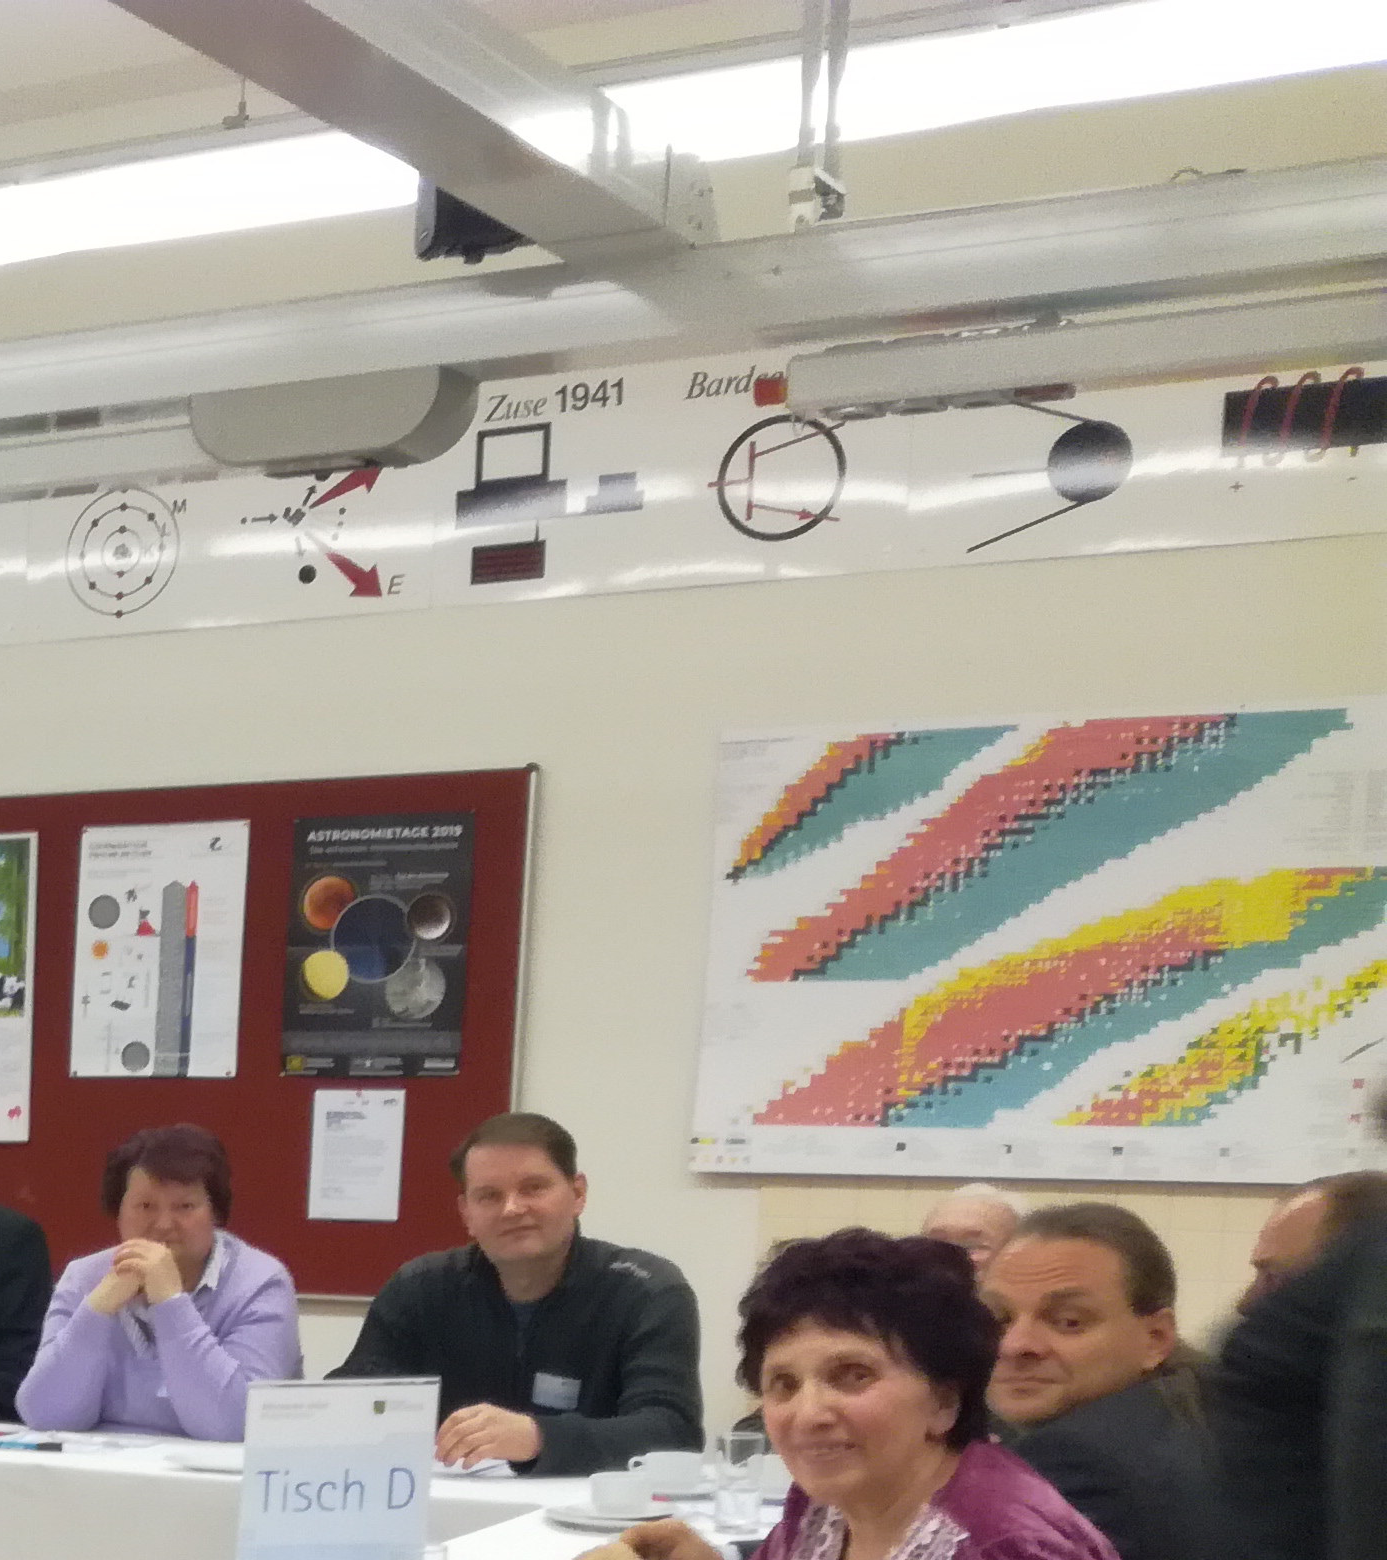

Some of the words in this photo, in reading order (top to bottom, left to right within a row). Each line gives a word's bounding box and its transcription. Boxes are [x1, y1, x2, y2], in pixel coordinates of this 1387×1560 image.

[484, 394, 548, 423] Zuse
[555, 377, 624, 413] 1941
[387, 573, 406, 596] E
[306, 826, 430, 842] ASTRONOMIETAGE
[431, 825, 464, 838] 2019
[256, 1469, 365, 1512] Tisch
[387, 1467, 416, 1510] D
